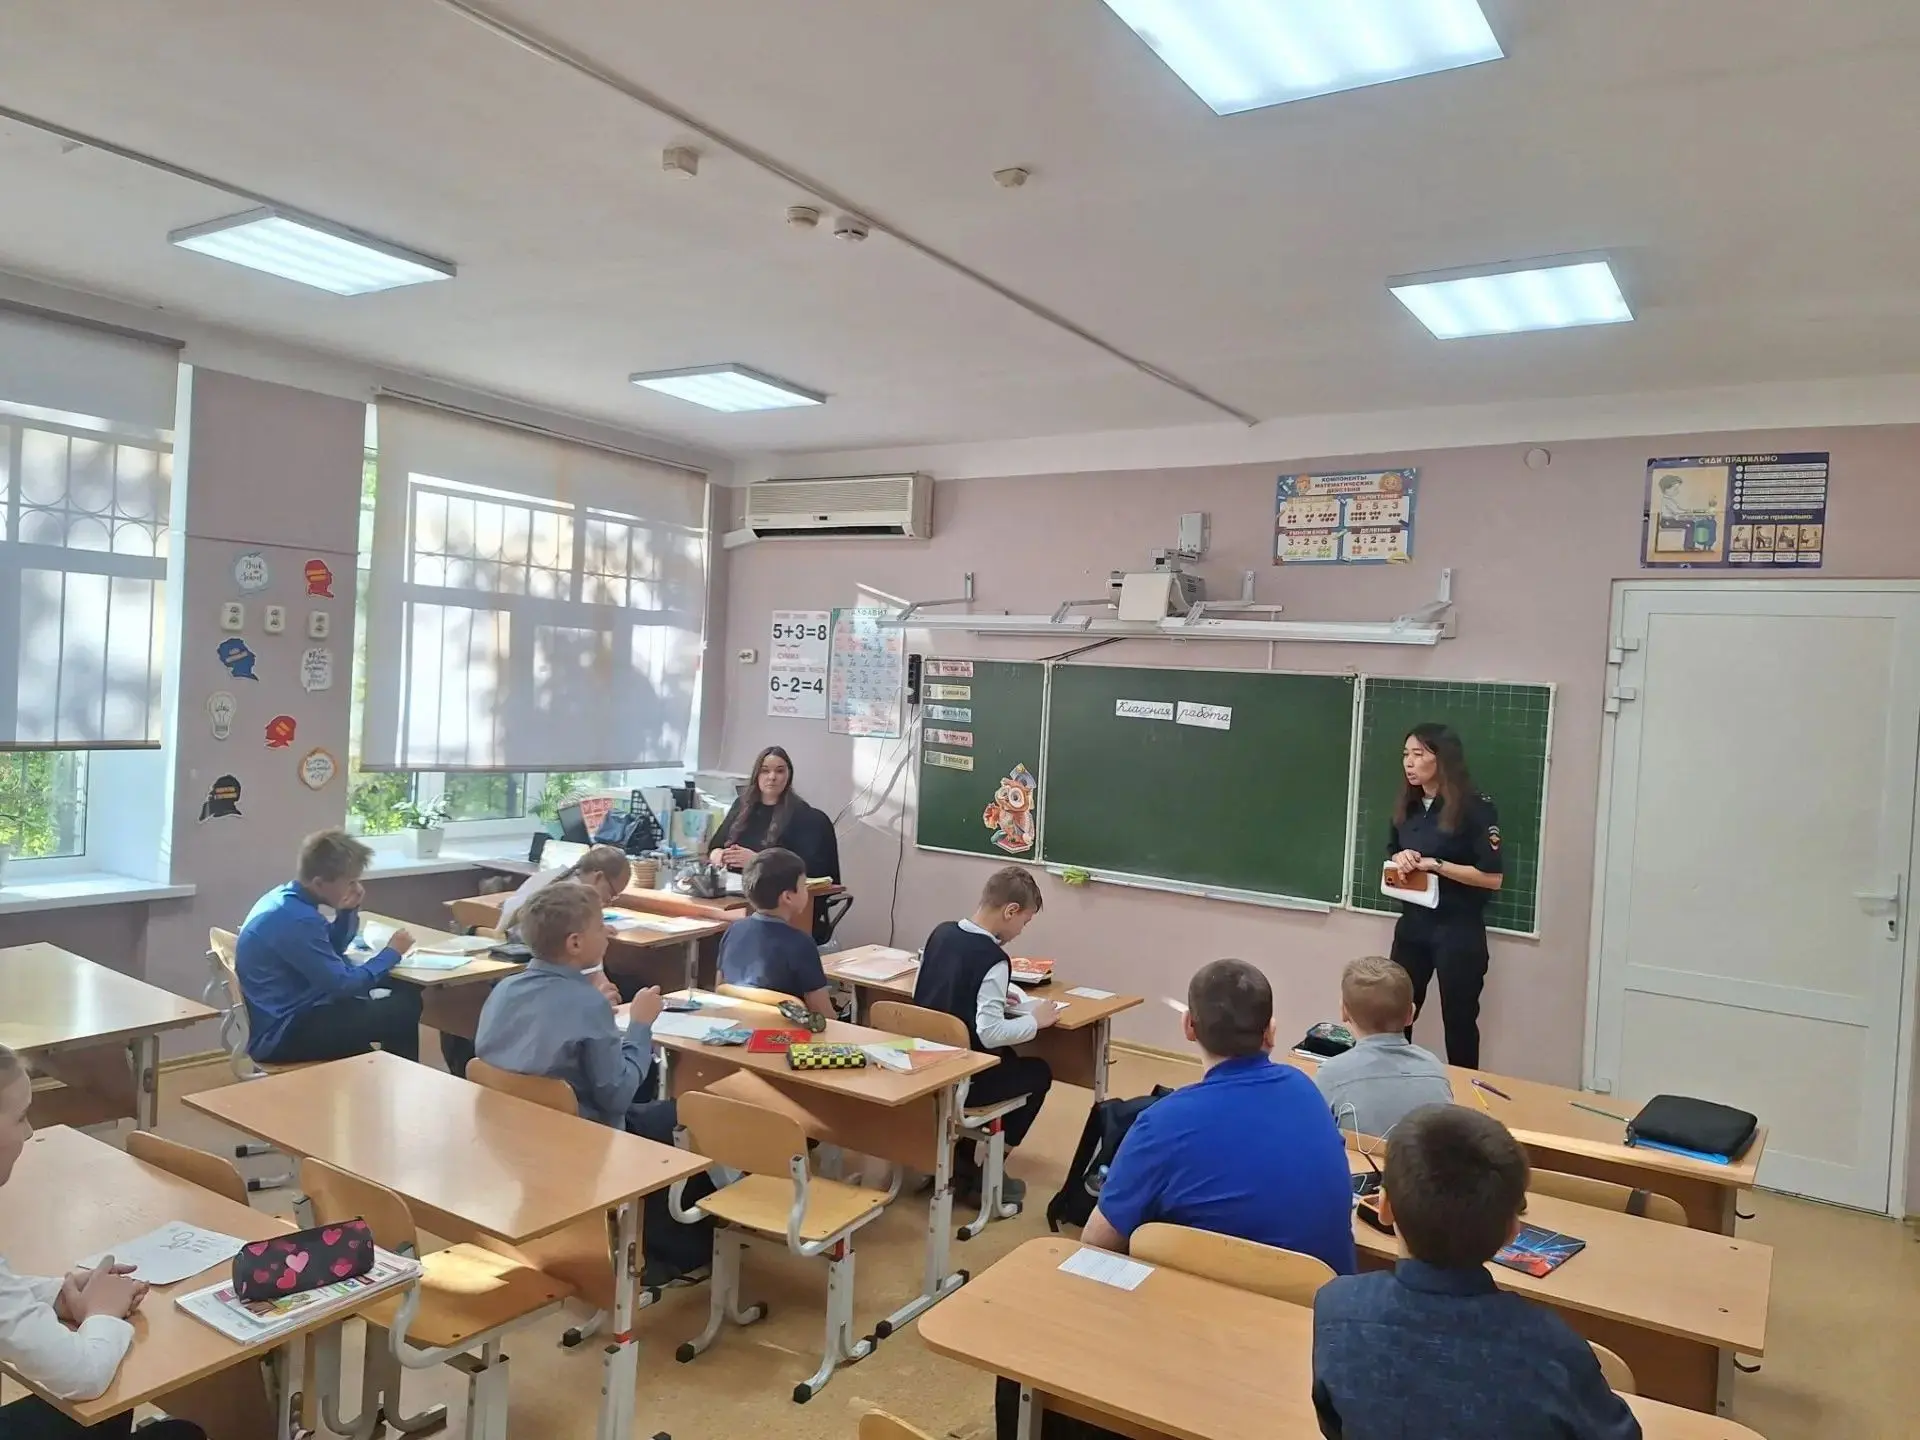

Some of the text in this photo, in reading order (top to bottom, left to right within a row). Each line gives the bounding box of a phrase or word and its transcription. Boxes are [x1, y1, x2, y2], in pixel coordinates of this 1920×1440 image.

[1698, 454, 1778, 465] СИДИ ПРАВИЛЬНО
[1288, 538, 1294, 546] 3
[1304, 538, 1310, 546] 2
[1321, 537, 1327, 545] 6
[1354, 536, 1360, 544] 4
[1390, 535, 1396, 543] 2
[773, 624, 827, 641] 5+3=8
[770, 676, 823, 694] 6-2=4
[1117, 701, 1230, 721] Классная работа
